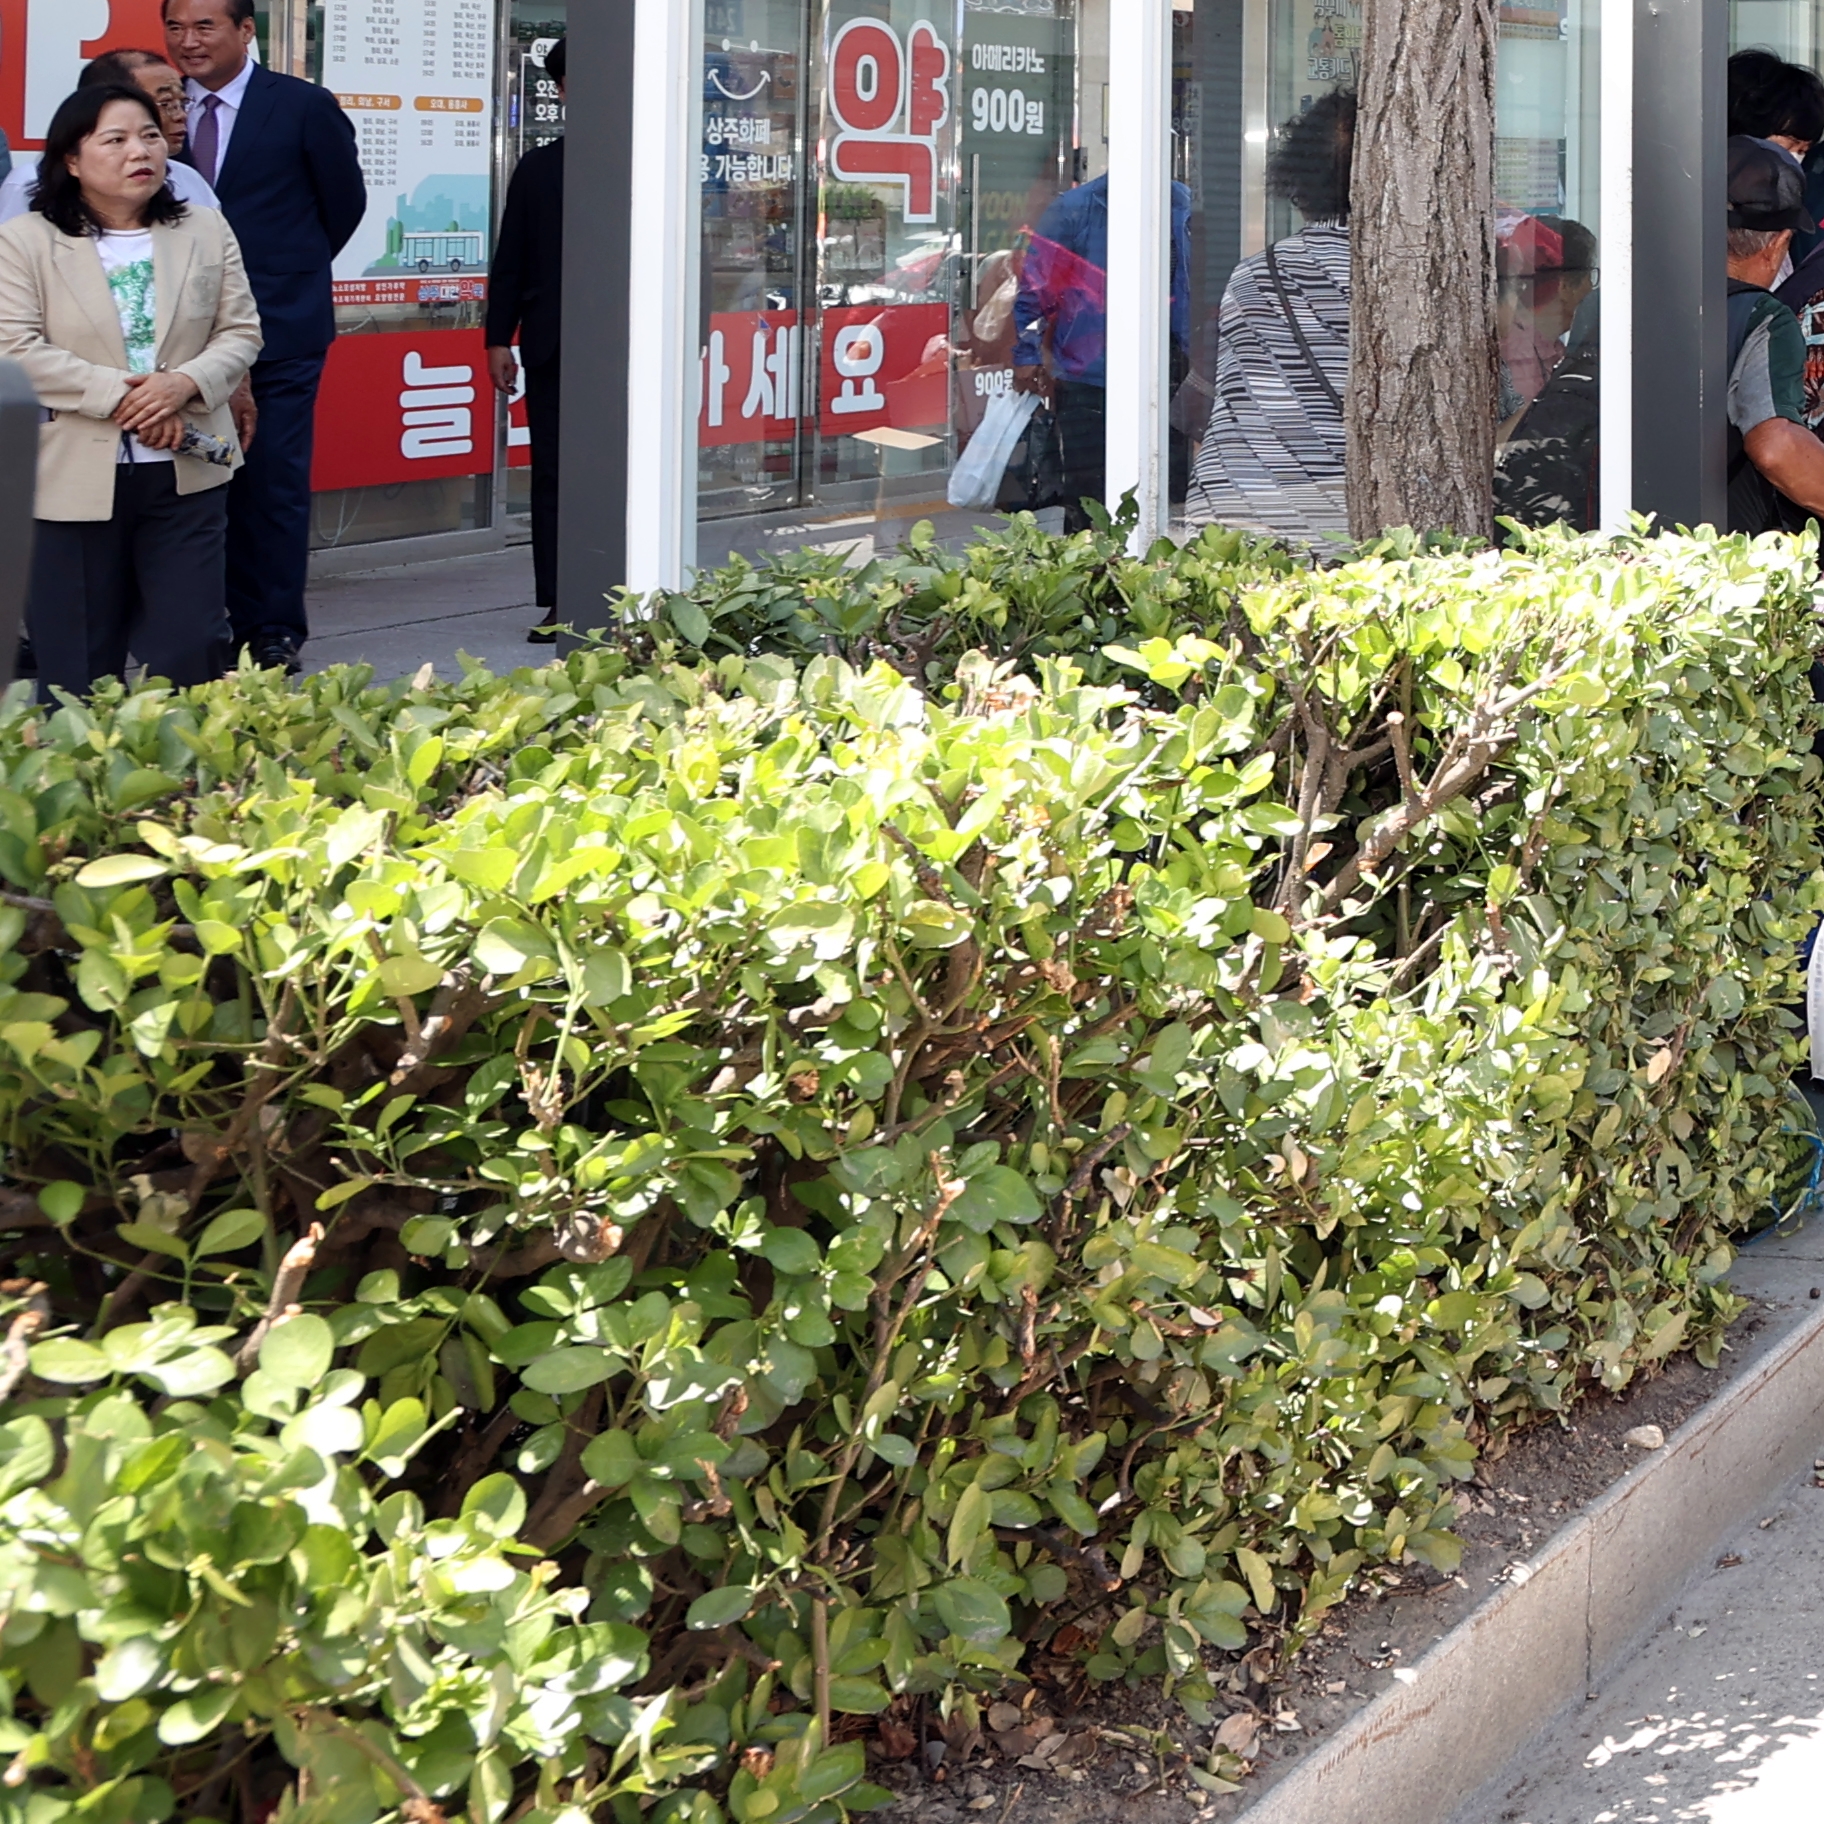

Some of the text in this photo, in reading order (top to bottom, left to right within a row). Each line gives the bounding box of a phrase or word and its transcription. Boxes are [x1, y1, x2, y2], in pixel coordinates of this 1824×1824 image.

[971, 43, 1046, 74] 아메리카노
[534, 103, 559, 122] 오후
[829, 17, 950, 223] 약
[971, 87, 1045, 135] 900원
[706, 117, 771, 146] 상주화폐
[715, 154, 797, 182] 가능합니다.
[400, 351, 475, 459] 늘
